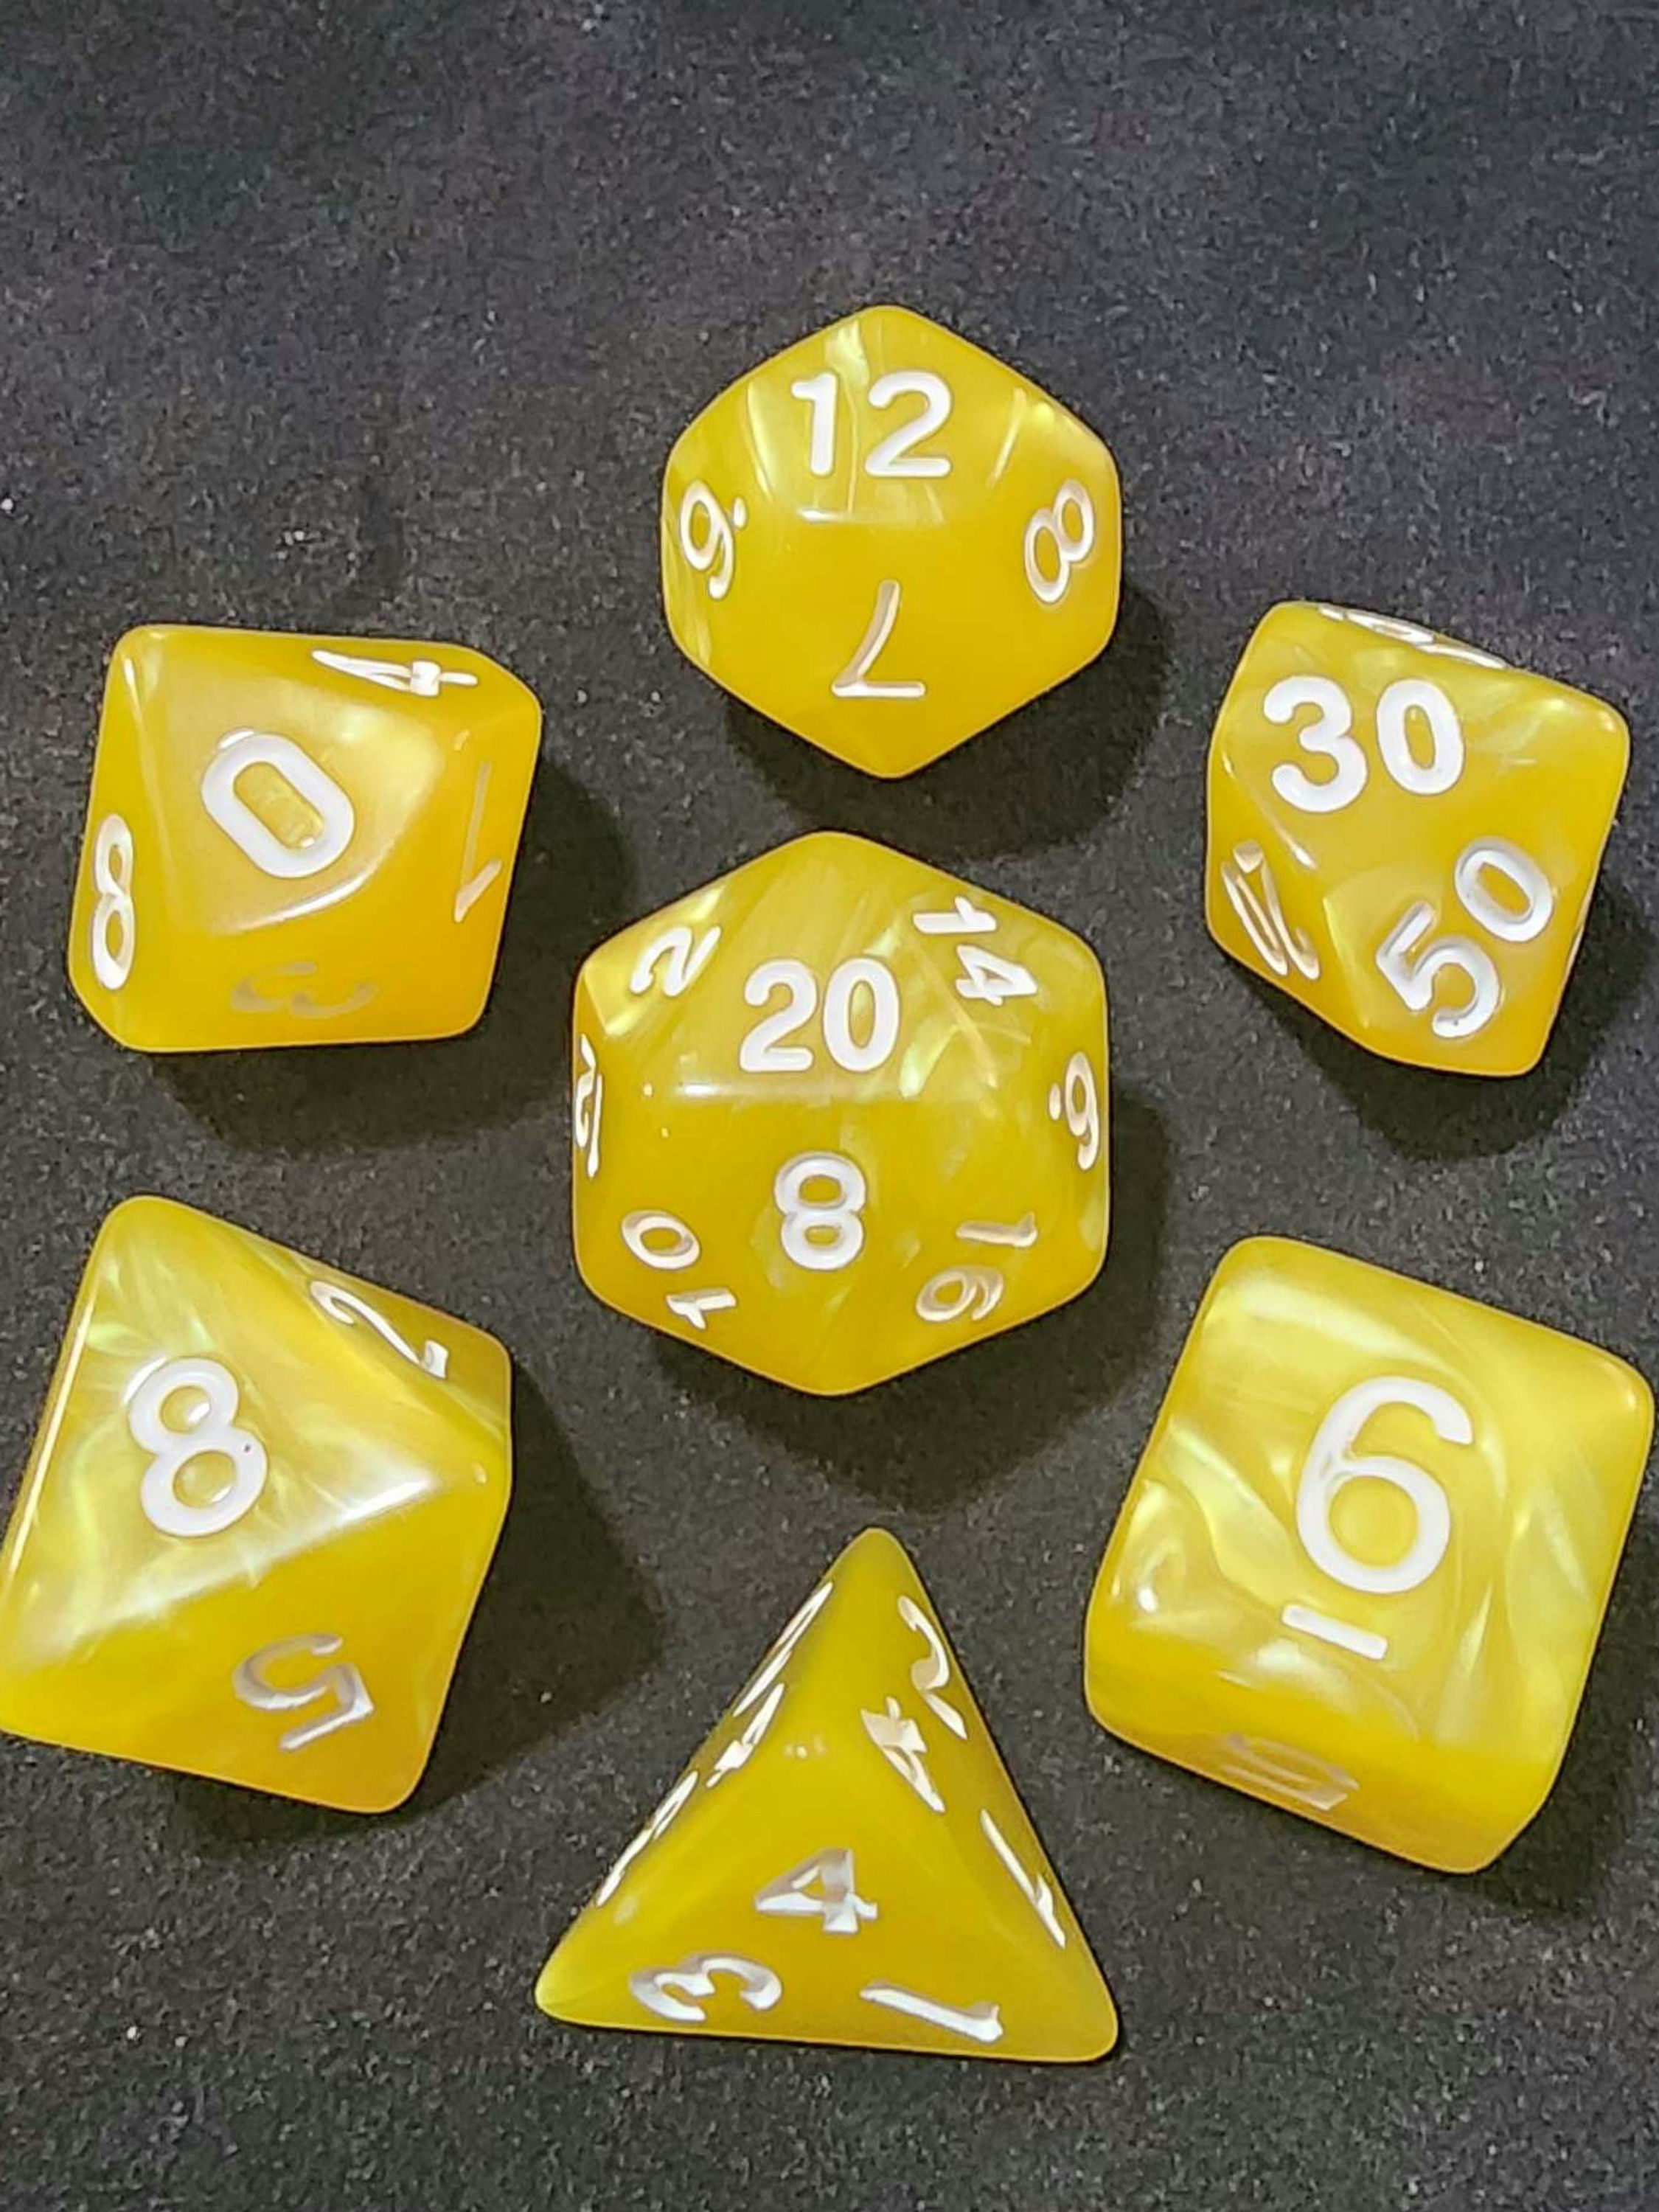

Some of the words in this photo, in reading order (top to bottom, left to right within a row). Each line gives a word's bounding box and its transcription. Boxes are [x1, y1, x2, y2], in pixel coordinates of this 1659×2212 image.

[790, 371, 952, 479] 12
[1023, 478, 1096, 605] 8
[310, 650, 478, 698] 4
[830, 578, 928, 698] 7
[1262, 672, 1467, 814] 30
[200, 730, 355, 879] 0
[453, 759, 501, 924] 1
[91, 813, 136, 992] 8
[629, 925, 723, 998] 2
[912, 896, 1037, 1006] 14
[1375, 835, 1553, 1041] 50
[739, 956, 900, 1074] 20
[621, 1209, 737, 1329] 10
[773, 1150, 866, 1272] 8
[914, 1211, 1039, 1324] 16
[307, 1279, 449, 1380] 2
[127, 1356, 268, 1539] 8
[1295, 1375, 1475, 1595] 6
[231, 1630, 374, 1752] 5
[897, 1595, 969, 1740] 2
[860, 1697, 946, 1814] 4
[753, 1846, 879, 1935] 4
[981, 1808, 1066, 1950] 1
[627, 1950, 783, 2023] 3
[858, 1978, 1004, 2045] 1
